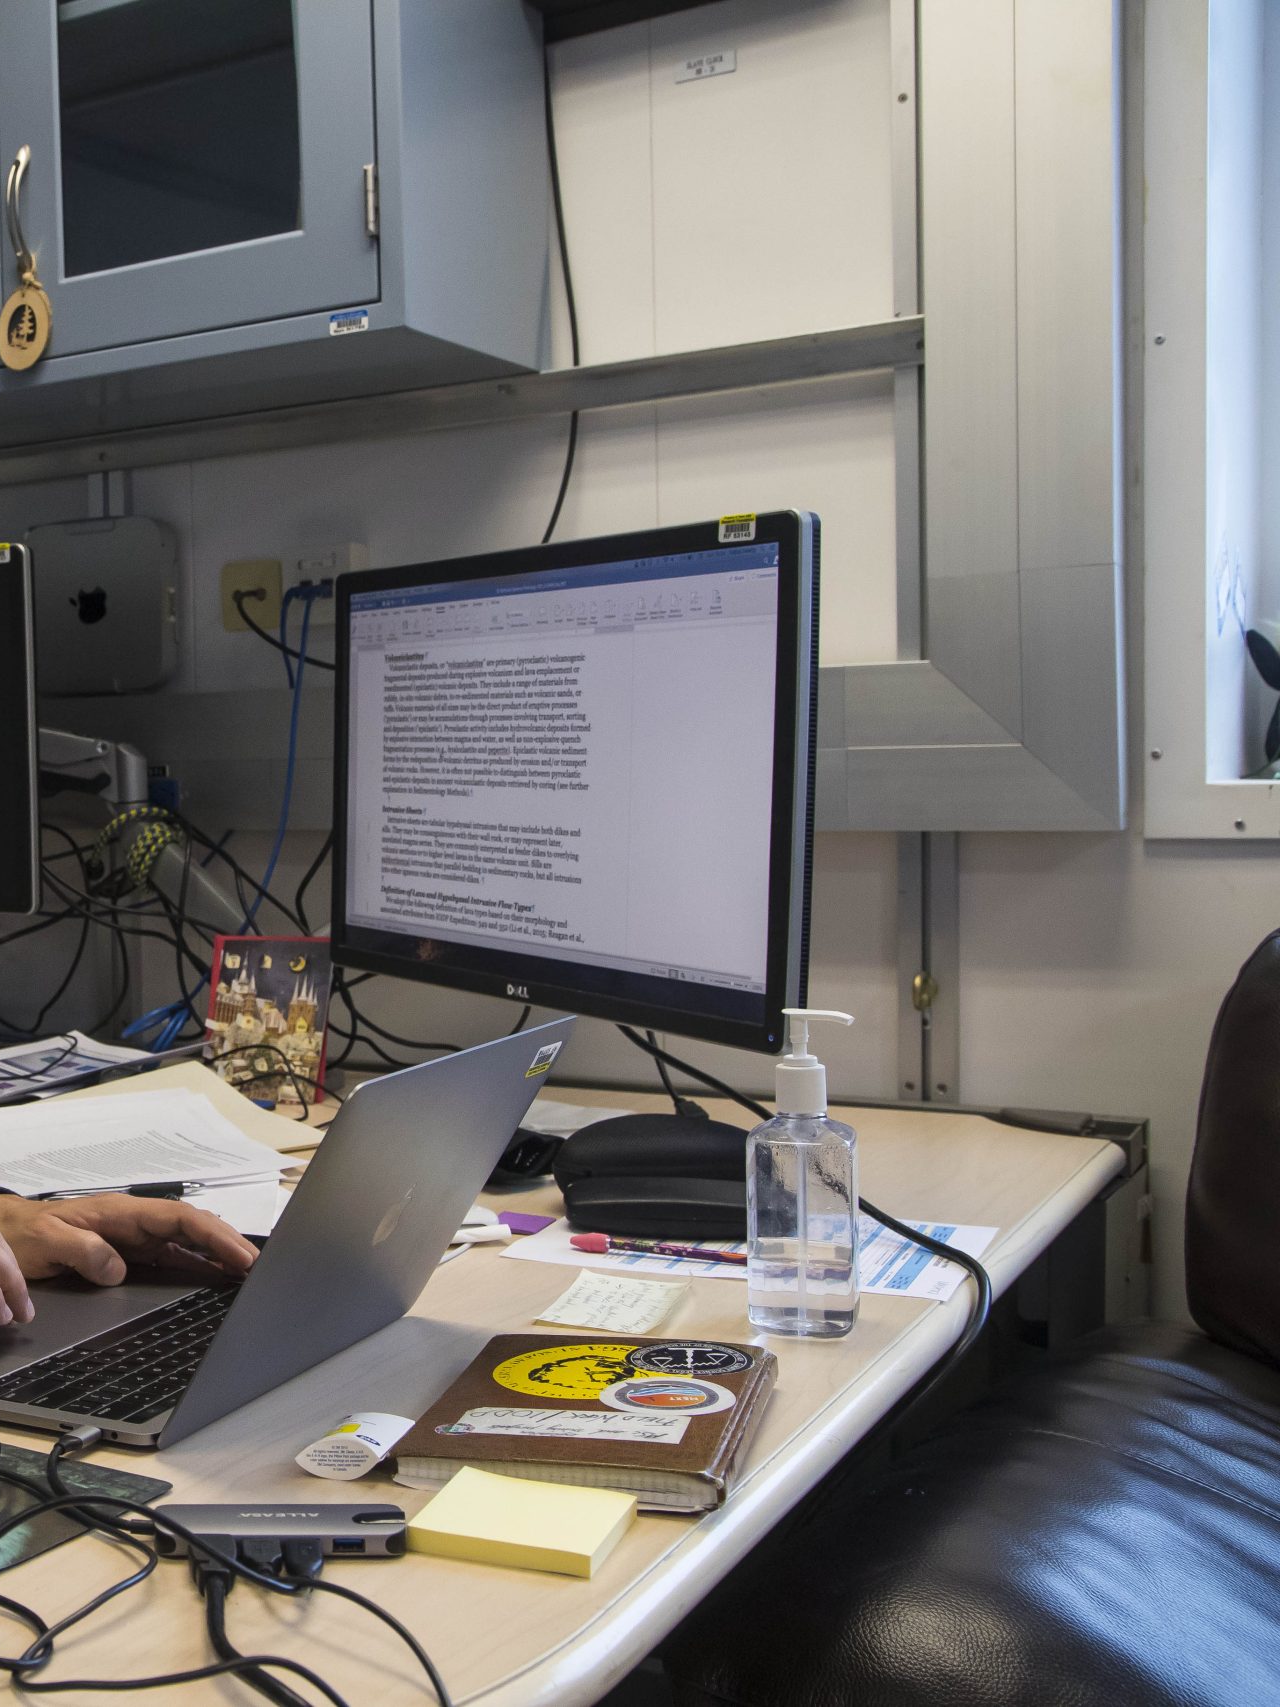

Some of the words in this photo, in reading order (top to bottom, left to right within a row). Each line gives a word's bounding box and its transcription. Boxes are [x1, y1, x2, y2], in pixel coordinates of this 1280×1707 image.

[549, 653, 585, 665] volcanogenic
[564, 676, 578, 685] from
[566, 712, 586, 722] sorting
[546, 723, 569, 733] deposits
[570, 723, 590, 732] formed
[560, 734, 581, 744] quench
[561, 746, 587, 754] sediment
[560, 758, 586, 768] transport
[551, 768, 581, 779] pyroclastic
[556, 780, 568, 791] (see
[569, 781, 589, 790] further
[554, 826, 569, 836] dikes
[570, 828, 581, 837] and
[553, 850, 579, 862] overlying
[554, 873, 582, 884] intrusions
[557, 919, 568, 928] and
[547, 928, 568, 941] Reagan
[568, 932, 574, 940] et
